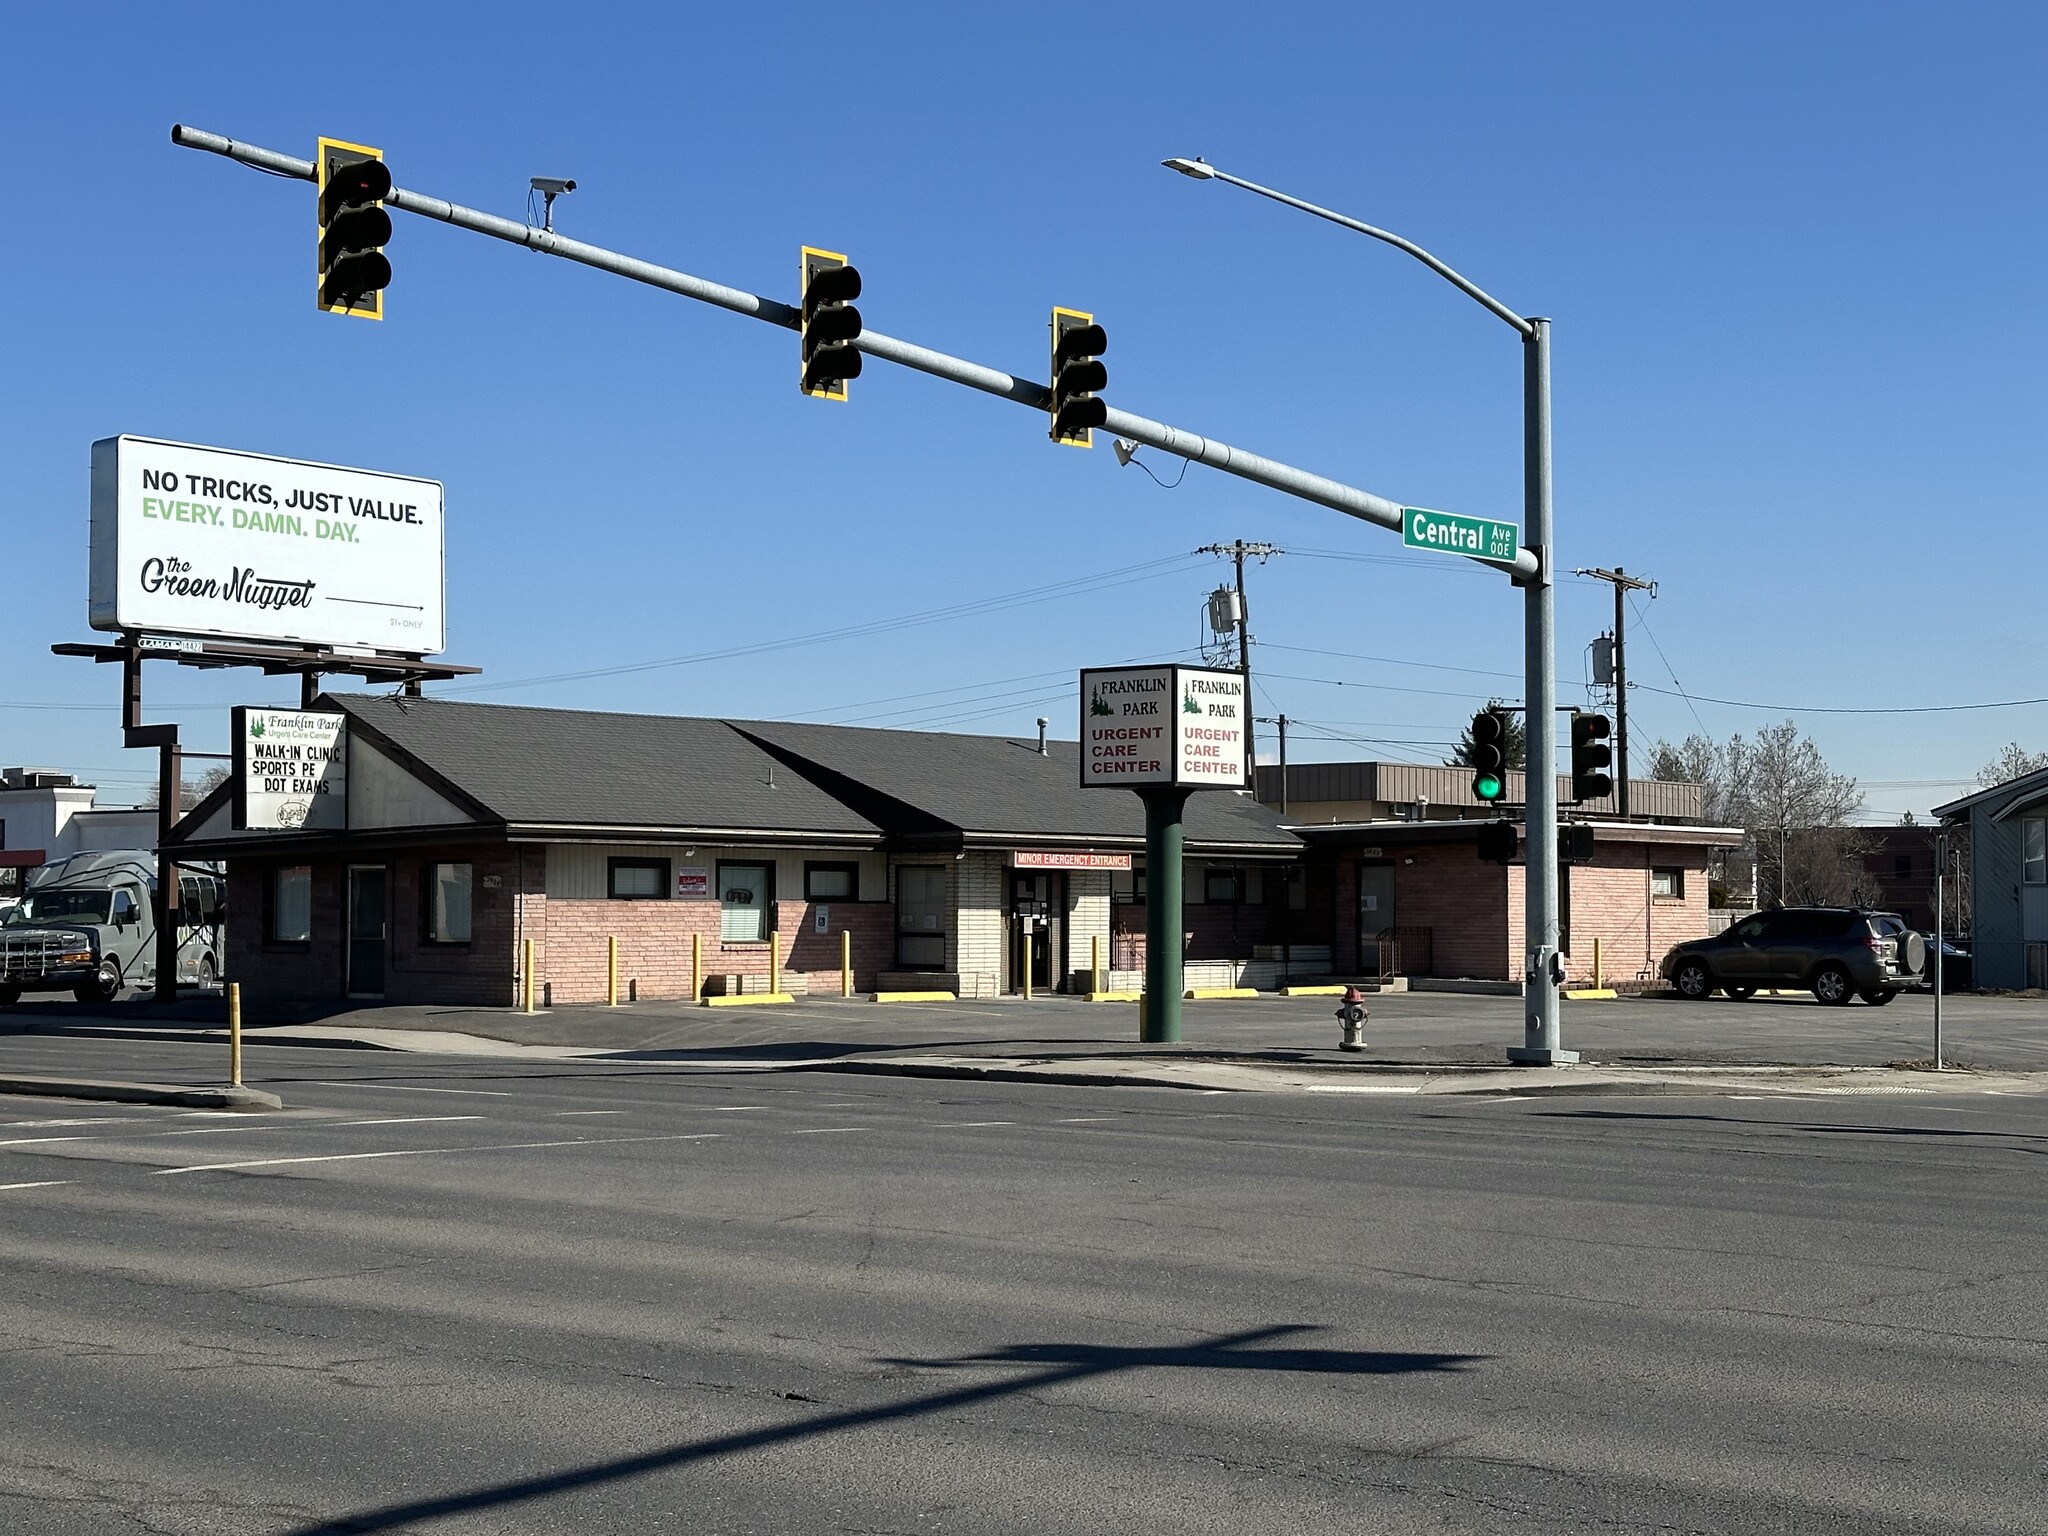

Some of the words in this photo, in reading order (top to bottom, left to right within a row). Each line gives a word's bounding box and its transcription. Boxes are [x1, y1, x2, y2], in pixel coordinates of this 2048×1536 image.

[143, 469, 178, 493] NO
[186, 474, 279, 510] TRICKS,
[285, 488, 343, 513] JUST
[349, 497, 423, 525] VALUE.
[143, 498, 225, 527] EVERY.
[233, 508, 308, 537] DAMN.
[316, 519, 360, 543] DAY.
[1413, 513, 1484, 550] Central
[1491, 524, 1511, 541] Ave
[167, 556, 192, 573] the
[141, 557, 221, 597] Green
[224, 566, 316, 610] Nugget
[402, 619, 423, 629] ONLY
[1101, 678, 1167, 695] FRANKLIN
[1191, 679, 1242, 696] FRANKLIN
[1123, 701, 1159, 716] PARK
[1209, 704, 1236, 718] PARK
[268, 715, 314, 731] Franklin
[317, 717, 344, 733] Park
[268, 729, 291, 739] Urgent
[292, 730, 309, 739] Care
[310, 731, 331, 739] Center
[1092, 726, 1163, 741] URGENT
[1184, 726, 1240, 742] URGENT
[255, 744, 301, 759] WALK-IN
[307, 746, 341, 761] CLINIC
[1092, 745, 1137, 757] CARE
[1184, 744, 1220, 757] CARE
[252, 761, 296, 775] SPORTS
[302, 762, 316, 776] PE
[1092, 760, 1161, 774] CENTER
[1184, 760, 1238, 775] CENTER
[265, 778, 287, 792] DOT
[293, 779, 330, 794] EXAMS
[1018, 853, 1042, 864] MINOR
[1044, 854, 1088, 866] EMERGENCY
[1091, 855, 1128, 866] ENTRANCE
